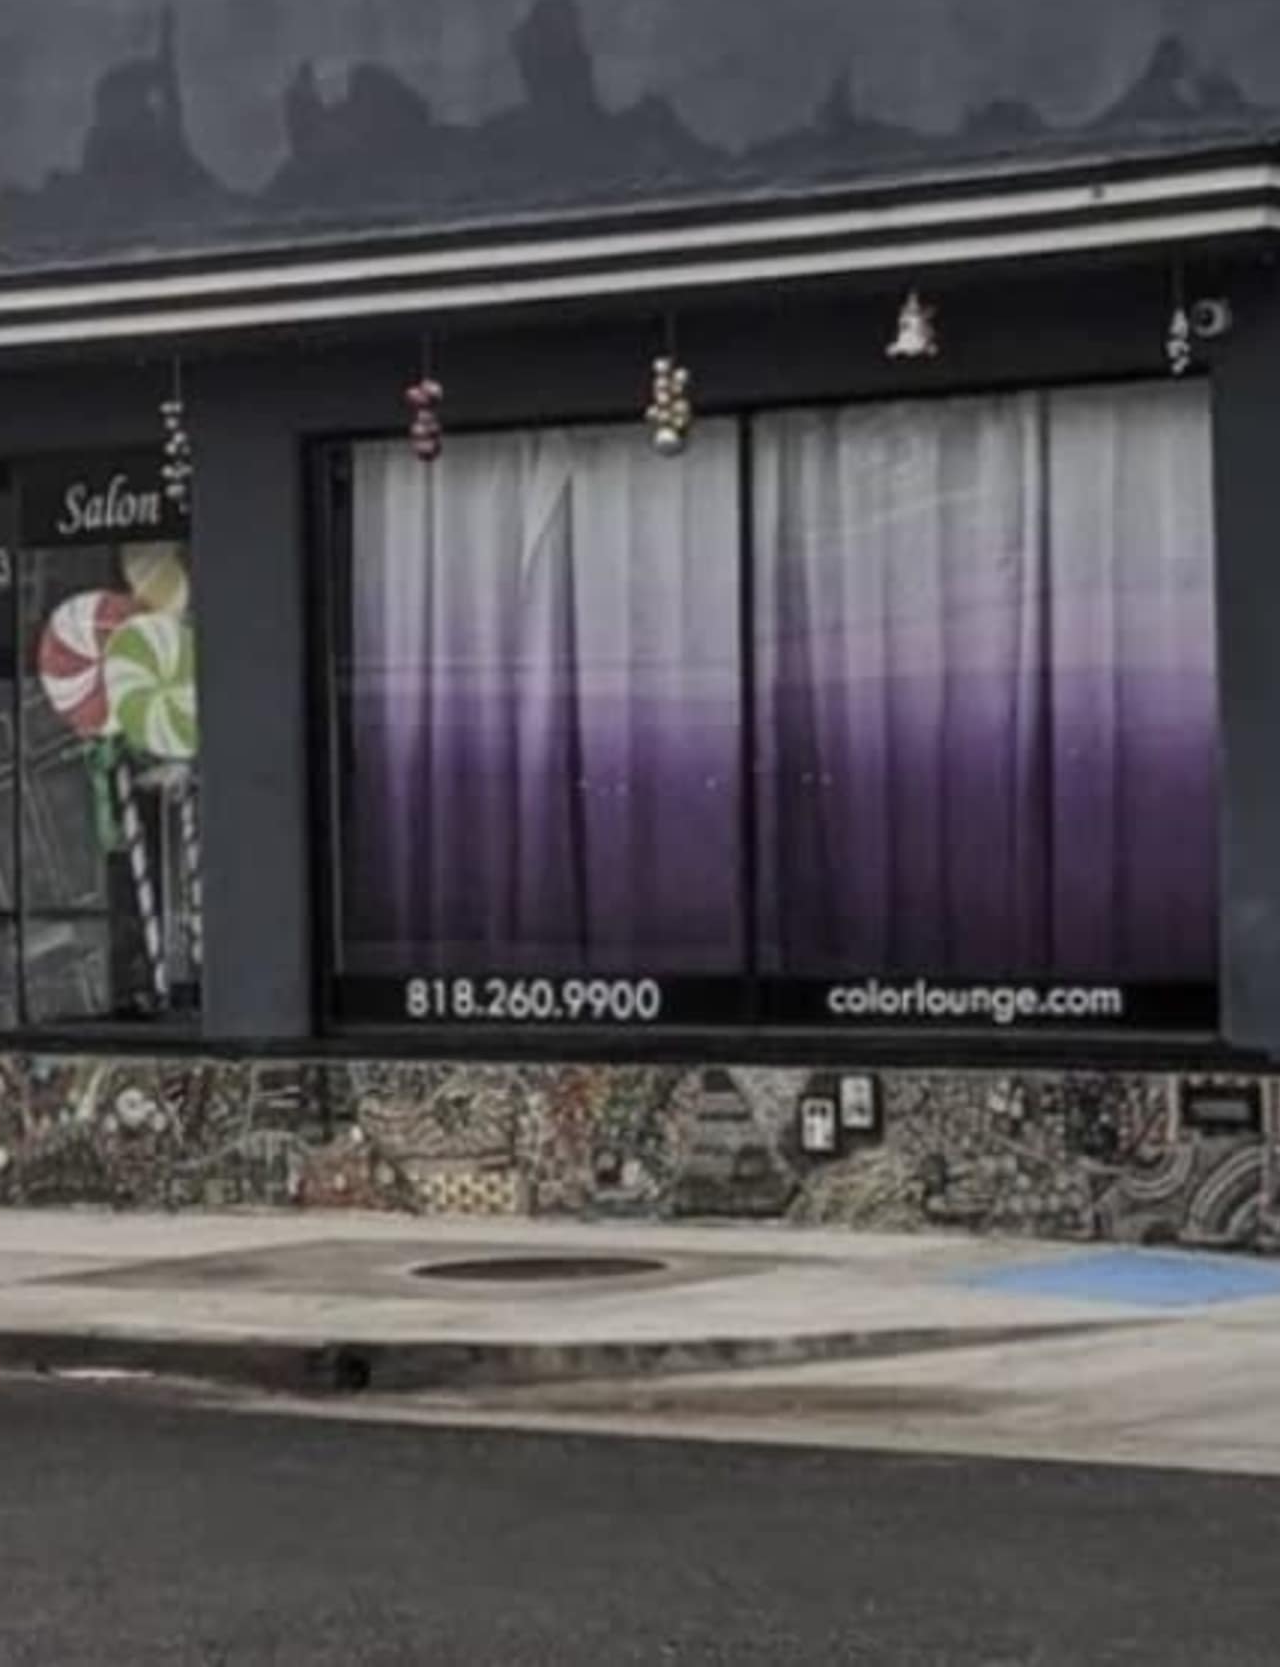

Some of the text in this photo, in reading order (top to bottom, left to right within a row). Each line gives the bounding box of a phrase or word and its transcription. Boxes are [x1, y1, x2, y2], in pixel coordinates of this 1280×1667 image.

[57, 474, 161, 535] Salon
[406, 978, 661, 1020] 818.260.9900
[826, 977, 1122, 1024] colorlounge.com
